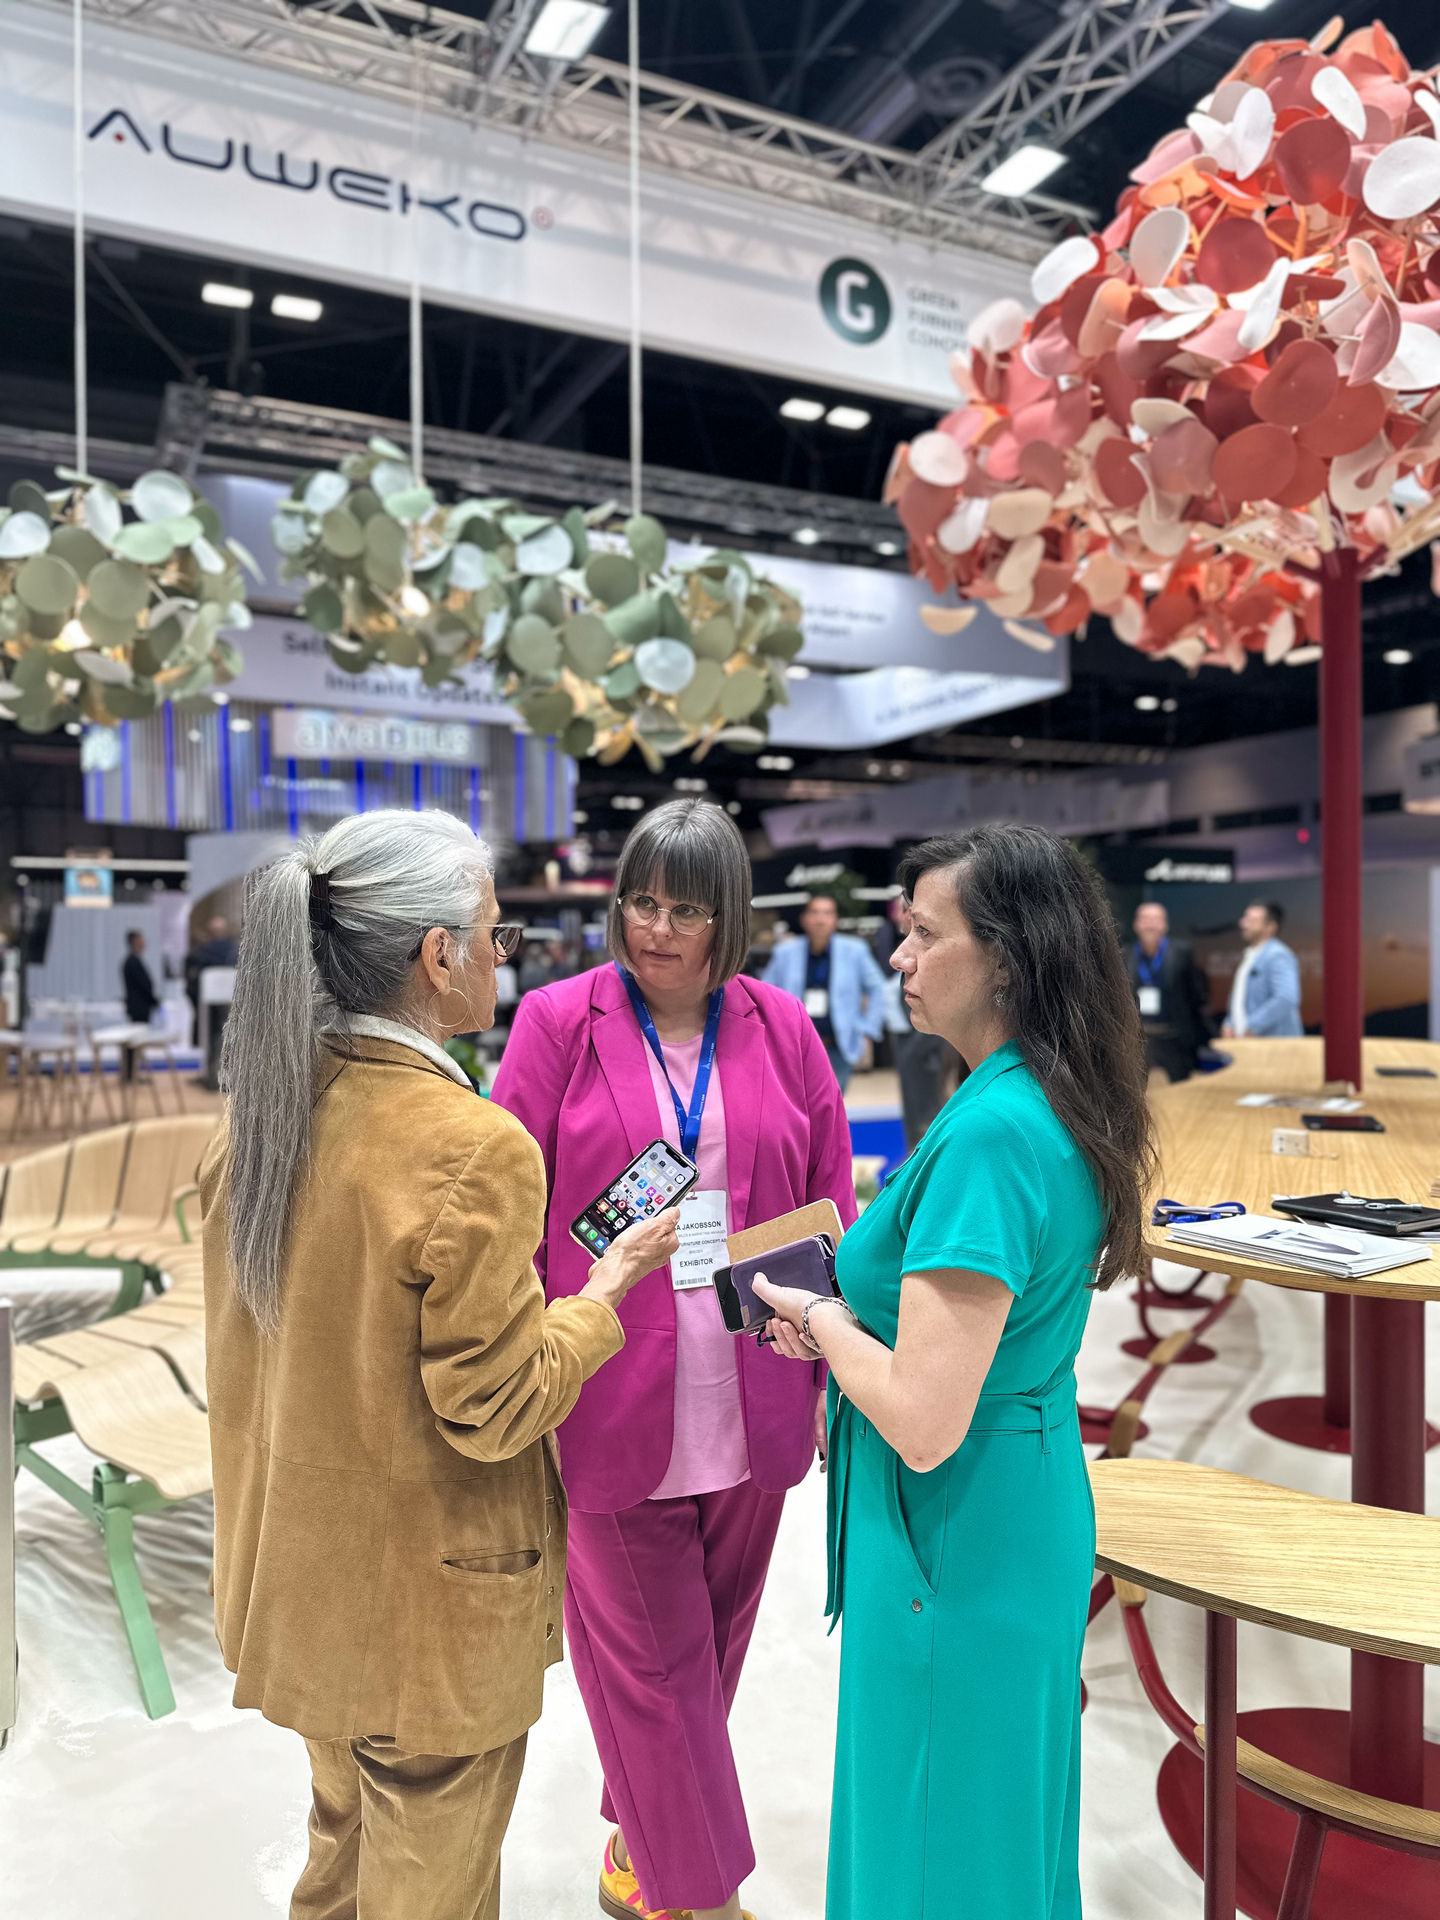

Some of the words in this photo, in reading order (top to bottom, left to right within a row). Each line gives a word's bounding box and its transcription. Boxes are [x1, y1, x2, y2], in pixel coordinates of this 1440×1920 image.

[88, 108, 527, 242] AUWEKO
[836, 270, 875, 332] G
[682, 1221, 722, 1231] JAKOBSSON
[680, 1258, 713, 1267] EXHIBITOR
